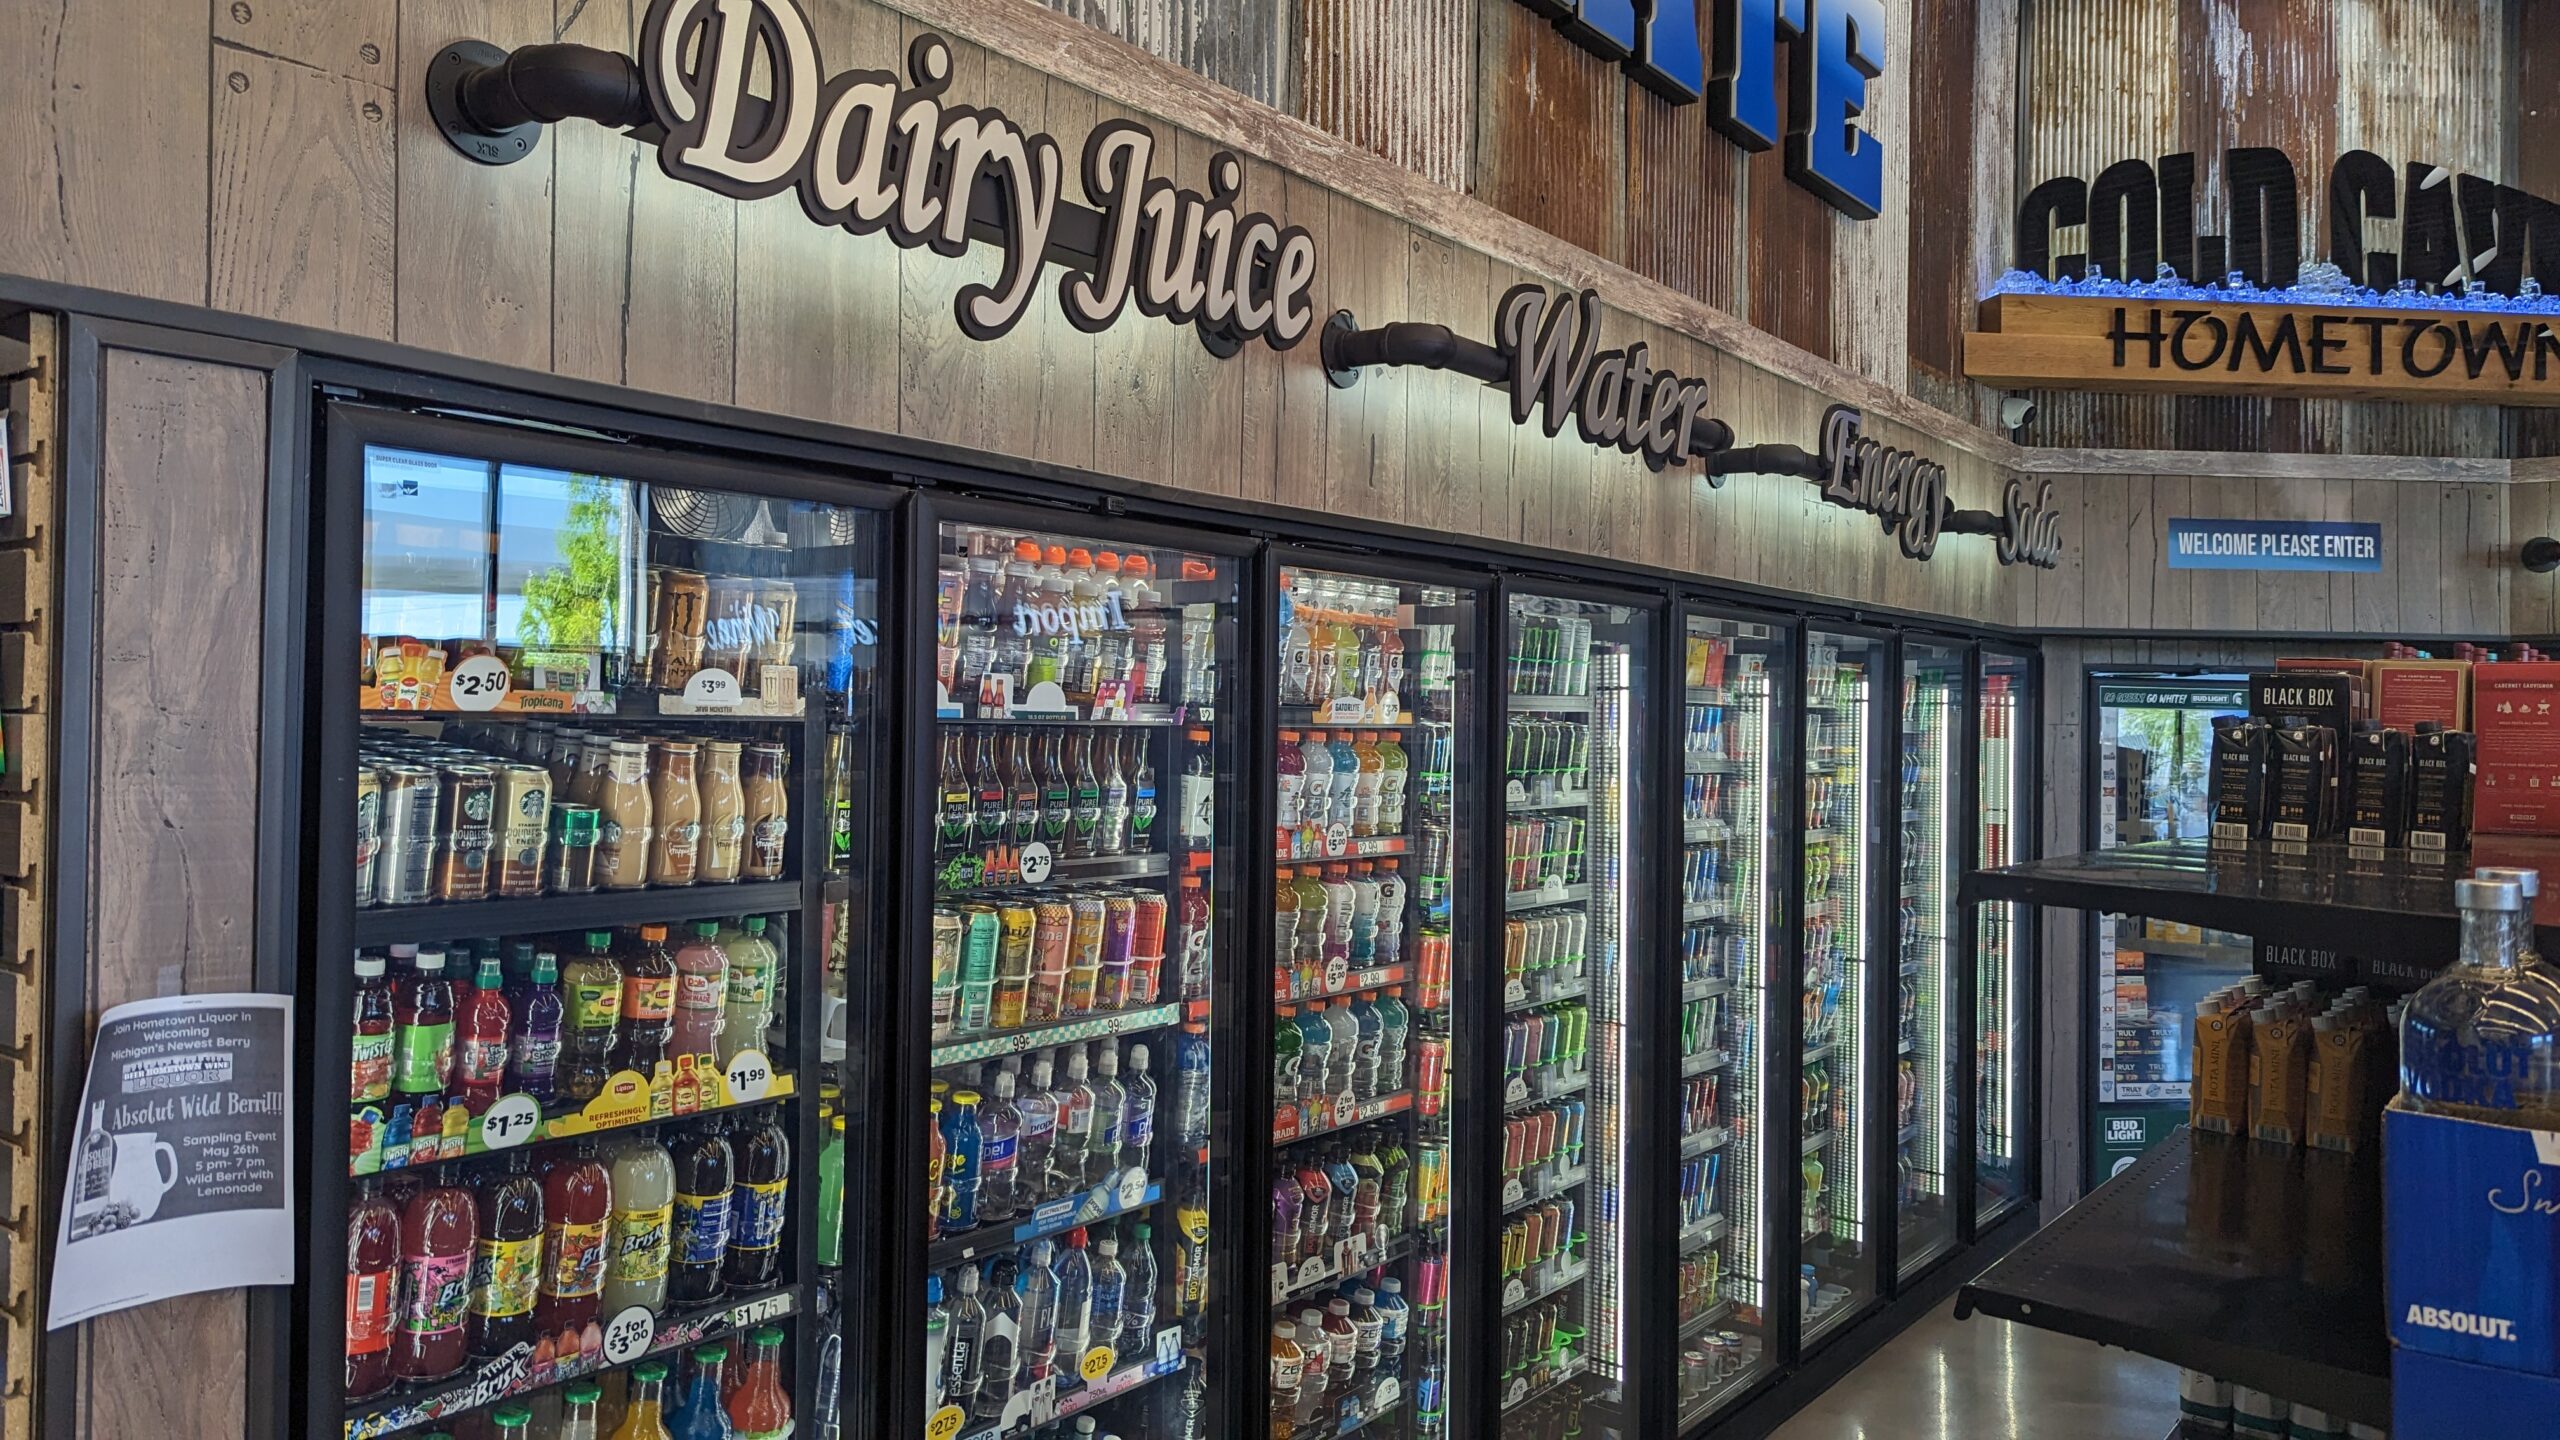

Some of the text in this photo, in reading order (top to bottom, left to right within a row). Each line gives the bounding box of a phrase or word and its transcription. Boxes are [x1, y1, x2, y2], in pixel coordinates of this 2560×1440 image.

[642, 0, 1316, 350] Dairy Juice
[2019, 147, 2299, 287] COLD
[1495, 283, 1708, 467] Water
[1820, 404, 1946, 561] Energy
[1997, 479, 2063, 569] Soda
[2178, 532, 2375, 558] WELCOME PLEASE ENTER
[455, 669, 507, 696] $2.50
[519, 694, 564, 710] Tropicana
[2263, 687, 2334, 707] BLACK BOX
[1022, 856, 1050, 874] $2.75
[1002, 924, 1031, 939] AriZ
[2266, 945, 2336, 970] BLACK BOX
[688, 978, 706, 988] Dole
[728, 986, 752, 998] NADE
[113, 1012, 252, 1036] Join Hometown Liquor in
[144, 1026, 210, 1042] Welcoming
[111, 1037, 251, 1062] Michigan's Newest Berry
[146, 1062, 202, 1076] HOMETOWN
[204, 1060, 230, 1070] WINE
[132, 1070, 220, 1092] LIQUOR
[614, 1082, 636, 1094] Lipton
[730, 1068, 766, 1090] $1.99
[2122, 1086, 2142, 1094] TRULY
[1340, 1096, 1345, 1104] 2
[112, 1098, 174, 1130] Absolut
[180, 1092, 222, 1120] Wild
[589, 1106, 647, 1122] REFRESHINGLY
[487, 1112, 534, 1137] $1.25
[596, 1115, 641, 1129] OPTIMISTIC
[2112, 1120, 2138, 1131] BUD
[183, 1131, 278, 1146] Sampling Event
[1274, 1126, 1295, 1140] ORADE
[2108, 1129, 2144, 1141] LIGHT
[202, 1144, 260, 1158] May 26th
[983, 1143, 1004, 1160] pel
[195, 1160, 204, 1171] 5
[236, 1158, 243, 1168] 7
[246, 1158, 266, 1169] pm
[185, 1168, 274, 1186] Wild Berri with
[198, 1183, 263, 1198] Lemonade
[737, 1300, 778, 1324] $1.75
[612, 1318, 648, 1338] 2 for
[609, 1329, 649, 1355] $3.00
[482, 1342, 526, 1378] THAT'S
[950, 1341, 967, 1397] essentia
